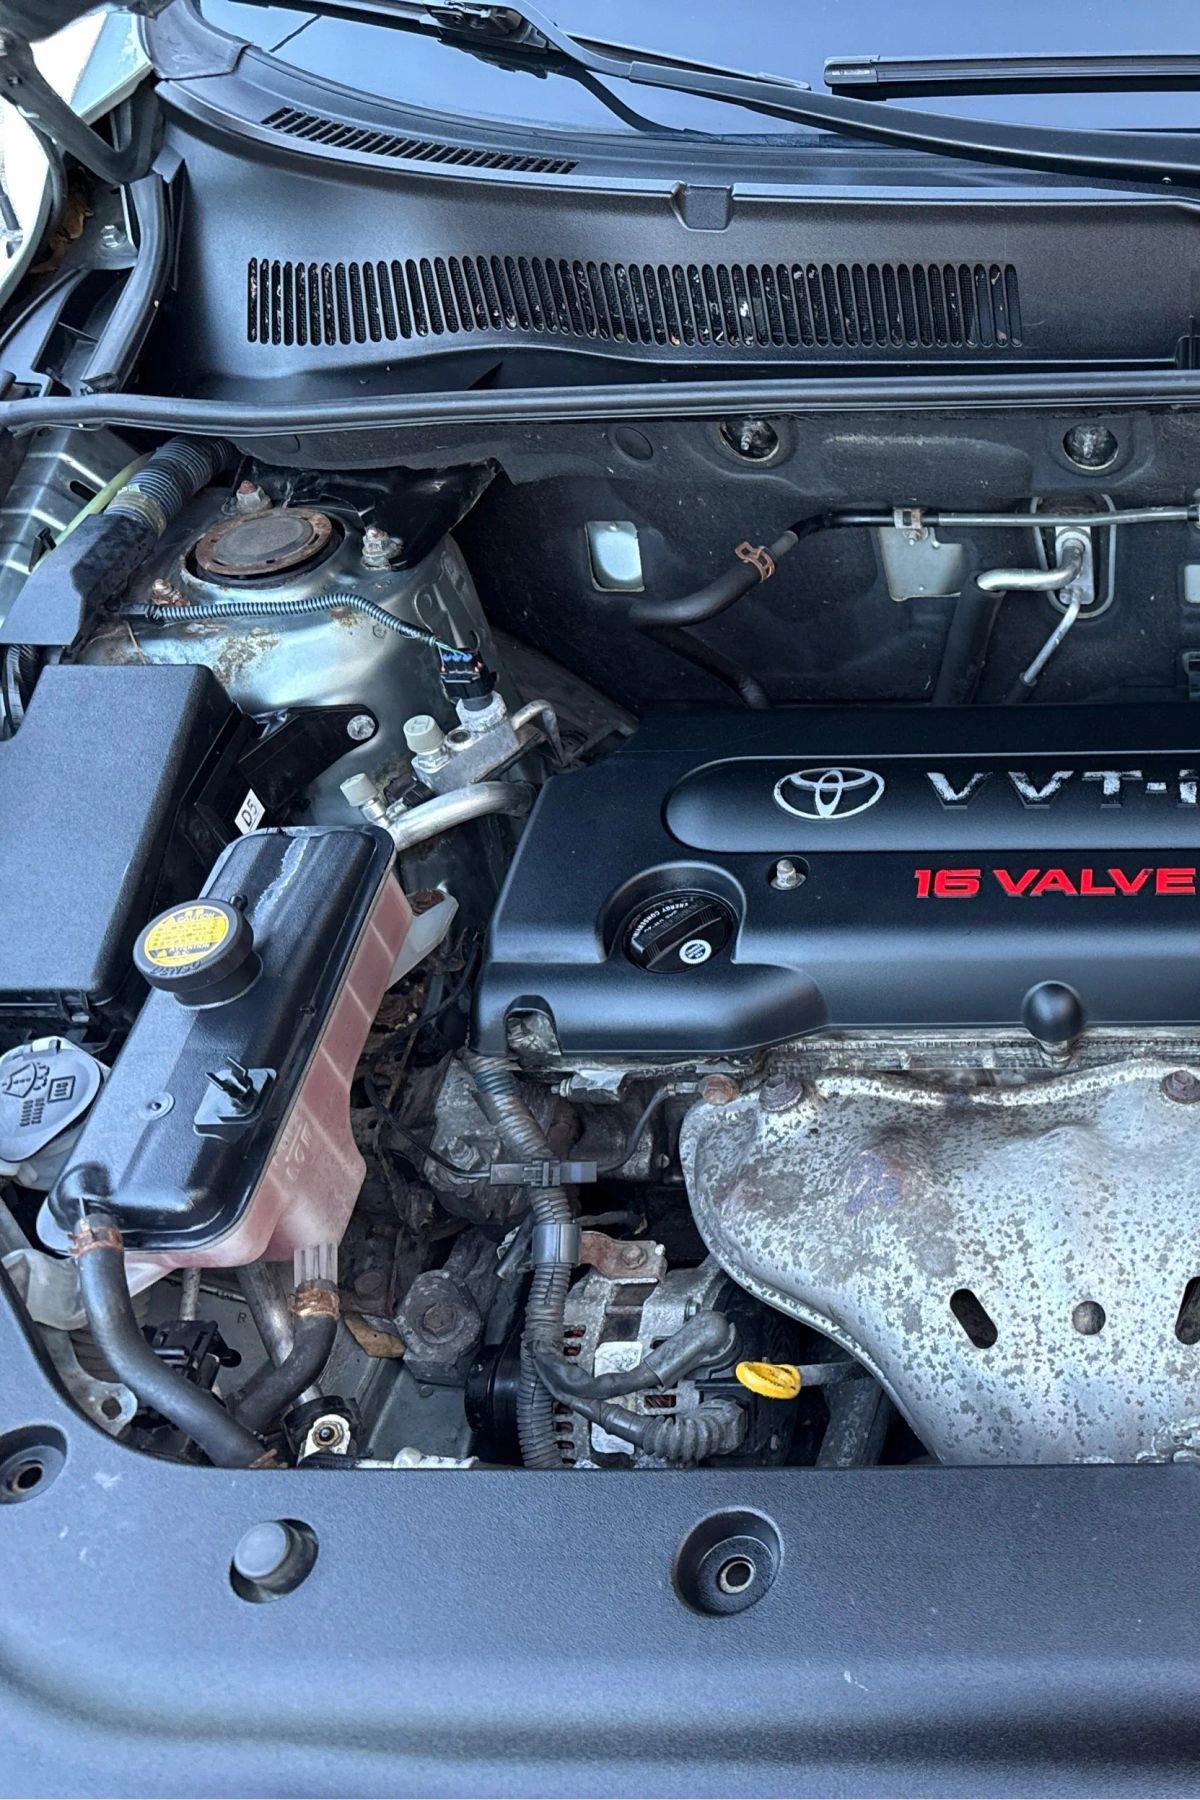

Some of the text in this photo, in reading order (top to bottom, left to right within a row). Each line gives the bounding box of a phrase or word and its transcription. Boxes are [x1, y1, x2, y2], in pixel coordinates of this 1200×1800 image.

[926, 768, 1197, 808] VVT-i
[914, 867, 1197, 898] 16 VALVE
